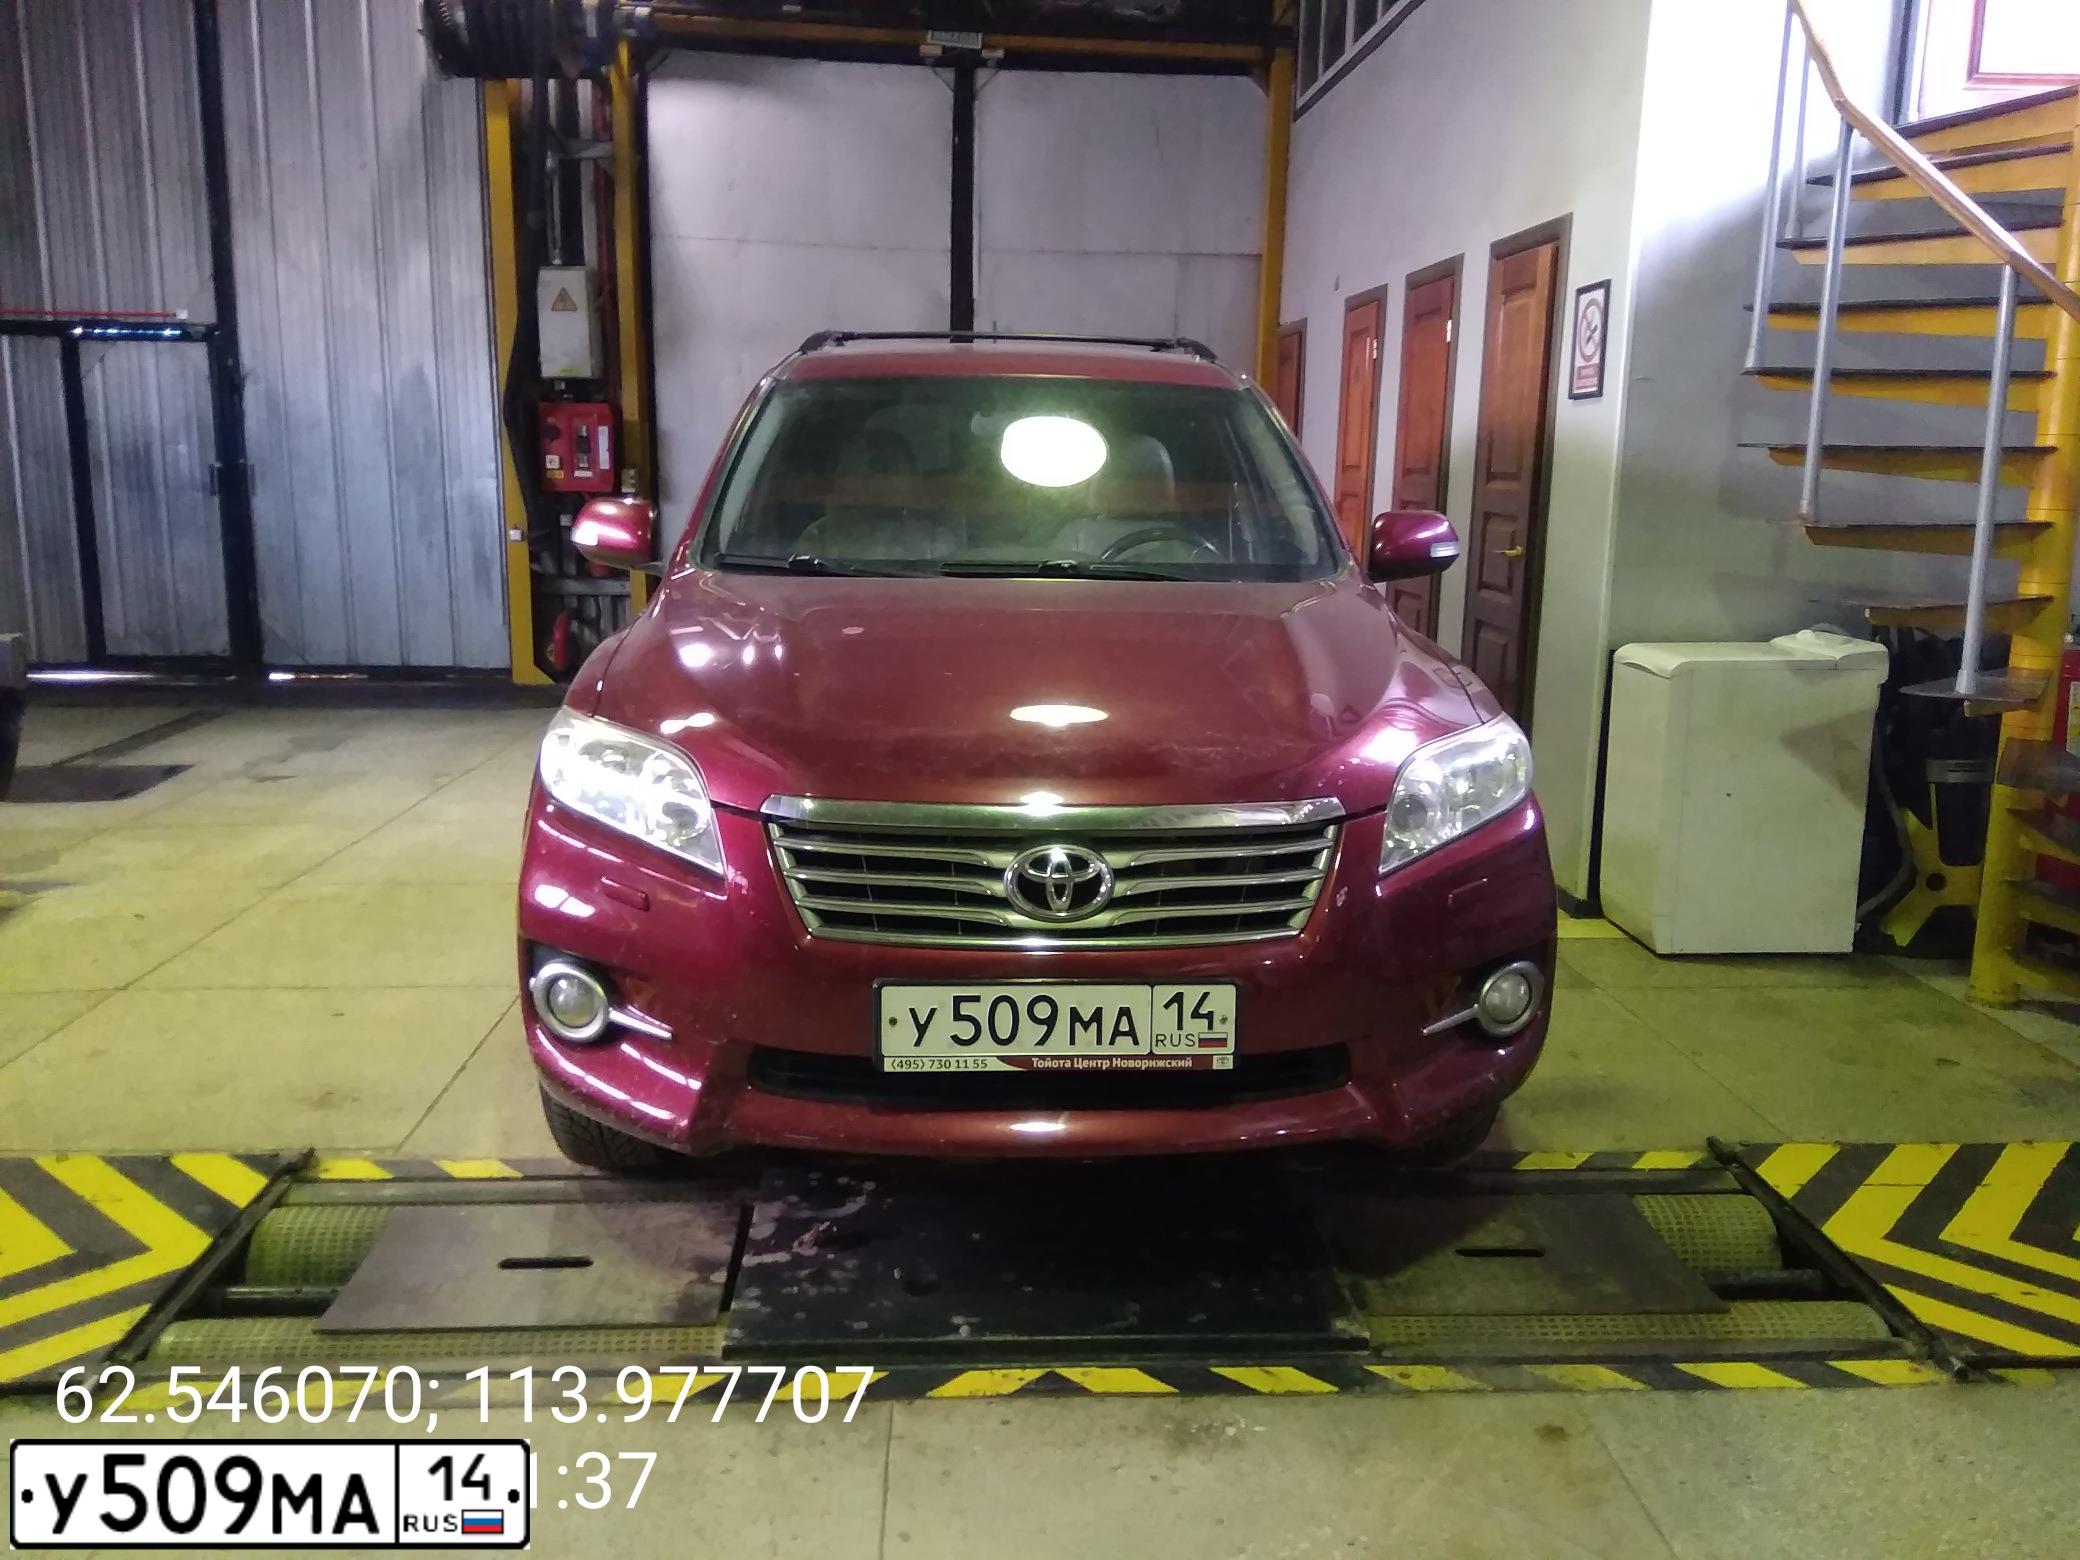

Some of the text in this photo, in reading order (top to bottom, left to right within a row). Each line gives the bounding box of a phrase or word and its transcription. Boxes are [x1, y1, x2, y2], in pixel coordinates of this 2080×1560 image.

[1162, 990, 1214, 1031] 14
[908, 993, 1140, 1048] У509МА
[1154, 1033, 1196, 1048] RUS
[891, 1059, 988, 1070] (495) 730 11 55
[1031, 1056, 1193, 1071] Тойота Центр Новорижский
